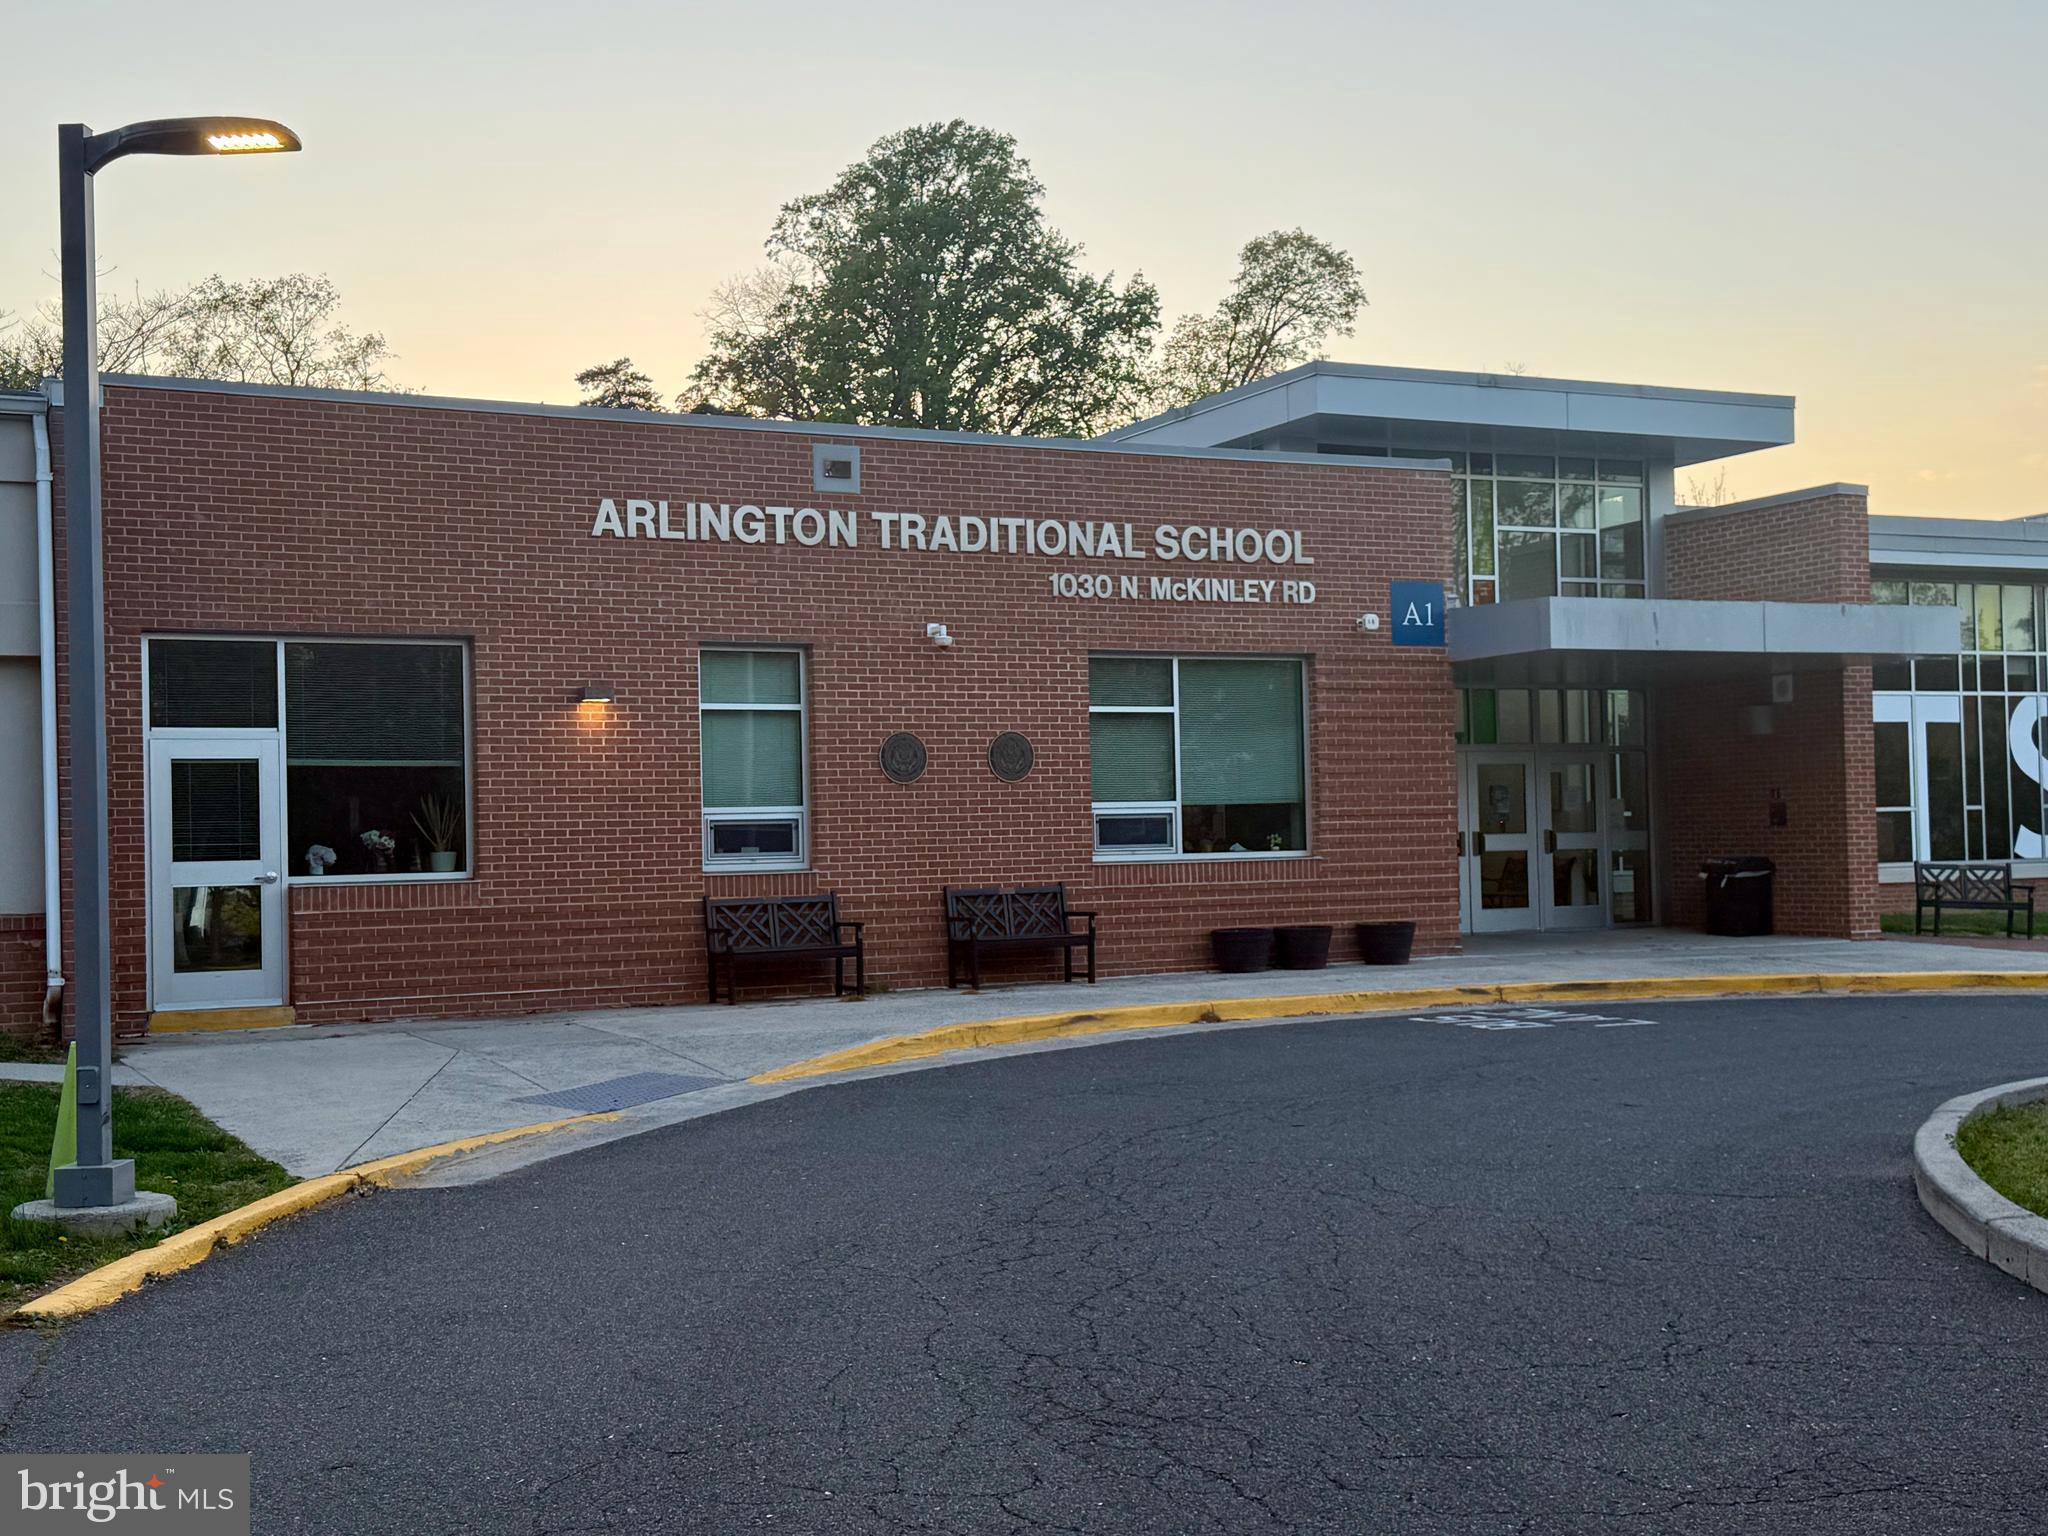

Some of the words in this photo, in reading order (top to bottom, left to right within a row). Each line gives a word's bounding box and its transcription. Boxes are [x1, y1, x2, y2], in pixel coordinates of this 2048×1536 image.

[591, 498, 857, 548] ARLINGTON
[871, 512, 1146, 559] TRADITIONAL
[1154, 525, 1314, 565] SCHOOL
[1049, 573, 1113, 599] 1030
[1120, 576, 1143, 599] N.
[1150, 576, 1277, 603] McKINLEY
[1282, 580, 1316, 604] RD
[1402, 602, 1434, 626] A1
